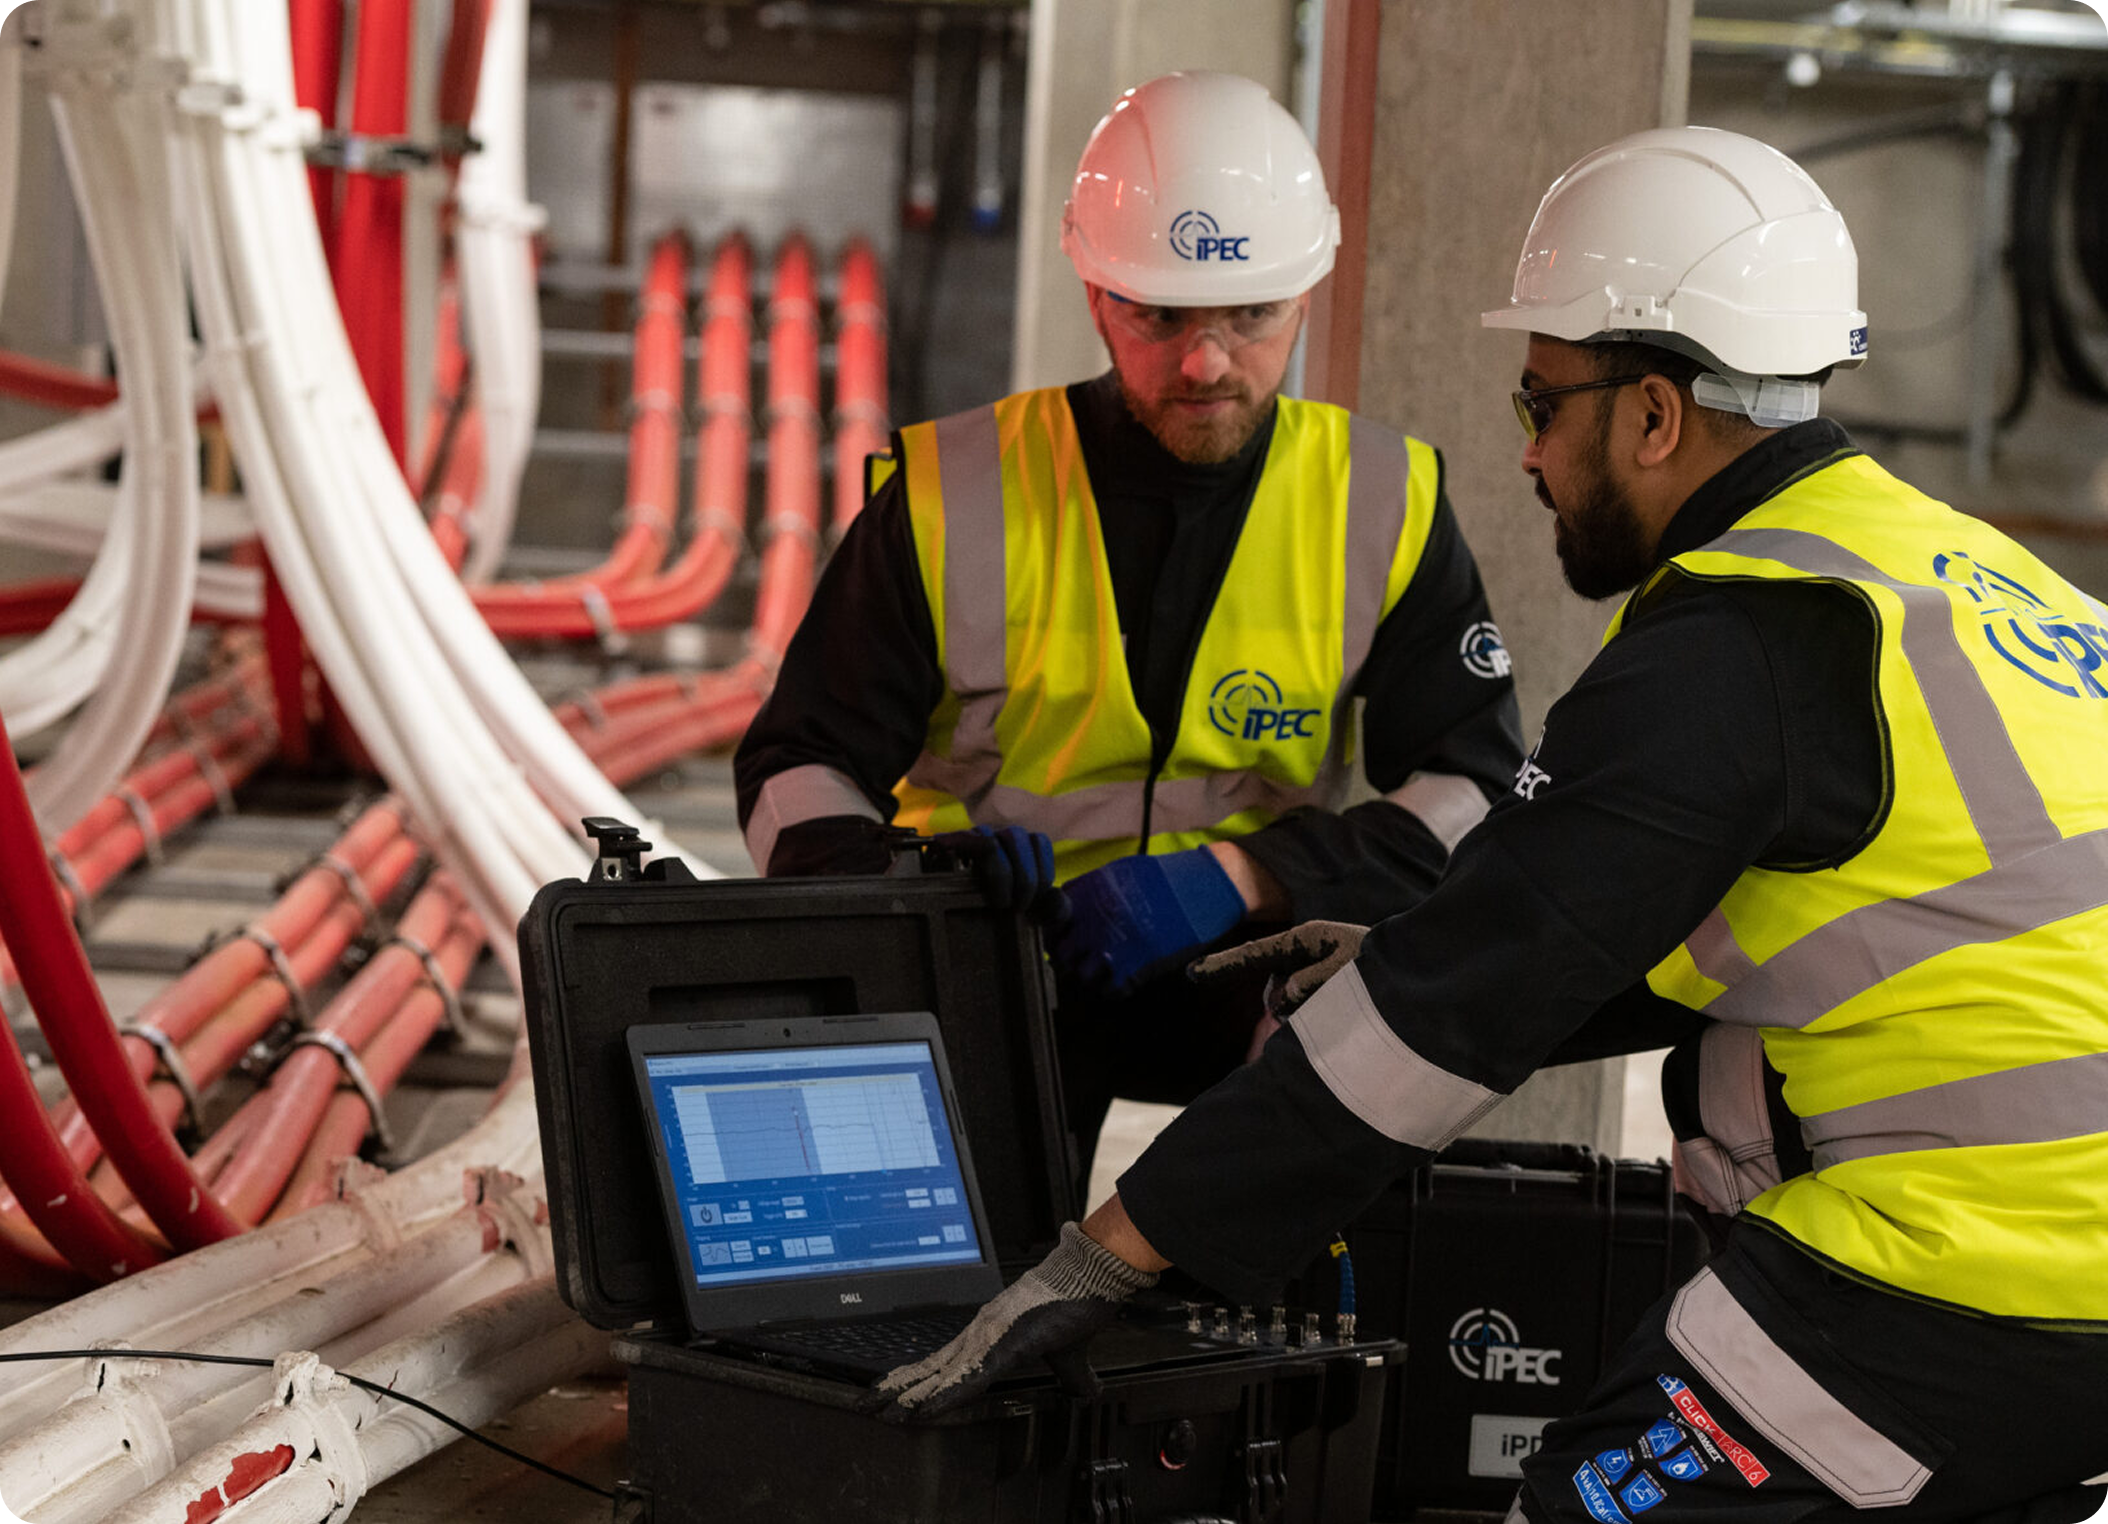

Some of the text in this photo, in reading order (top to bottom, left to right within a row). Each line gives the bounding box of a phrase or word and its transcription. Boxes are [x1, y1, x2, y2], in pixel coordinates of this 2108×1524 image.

[1196, 237, 1250, 261] iPEC
[1242, 708, 1322, 741] iPEC
[840, 1292, 863, 1304] DELL
[1484, 1346, 1562, 1385] iPEC
[1748, 1471, 1763, 1481] 6
